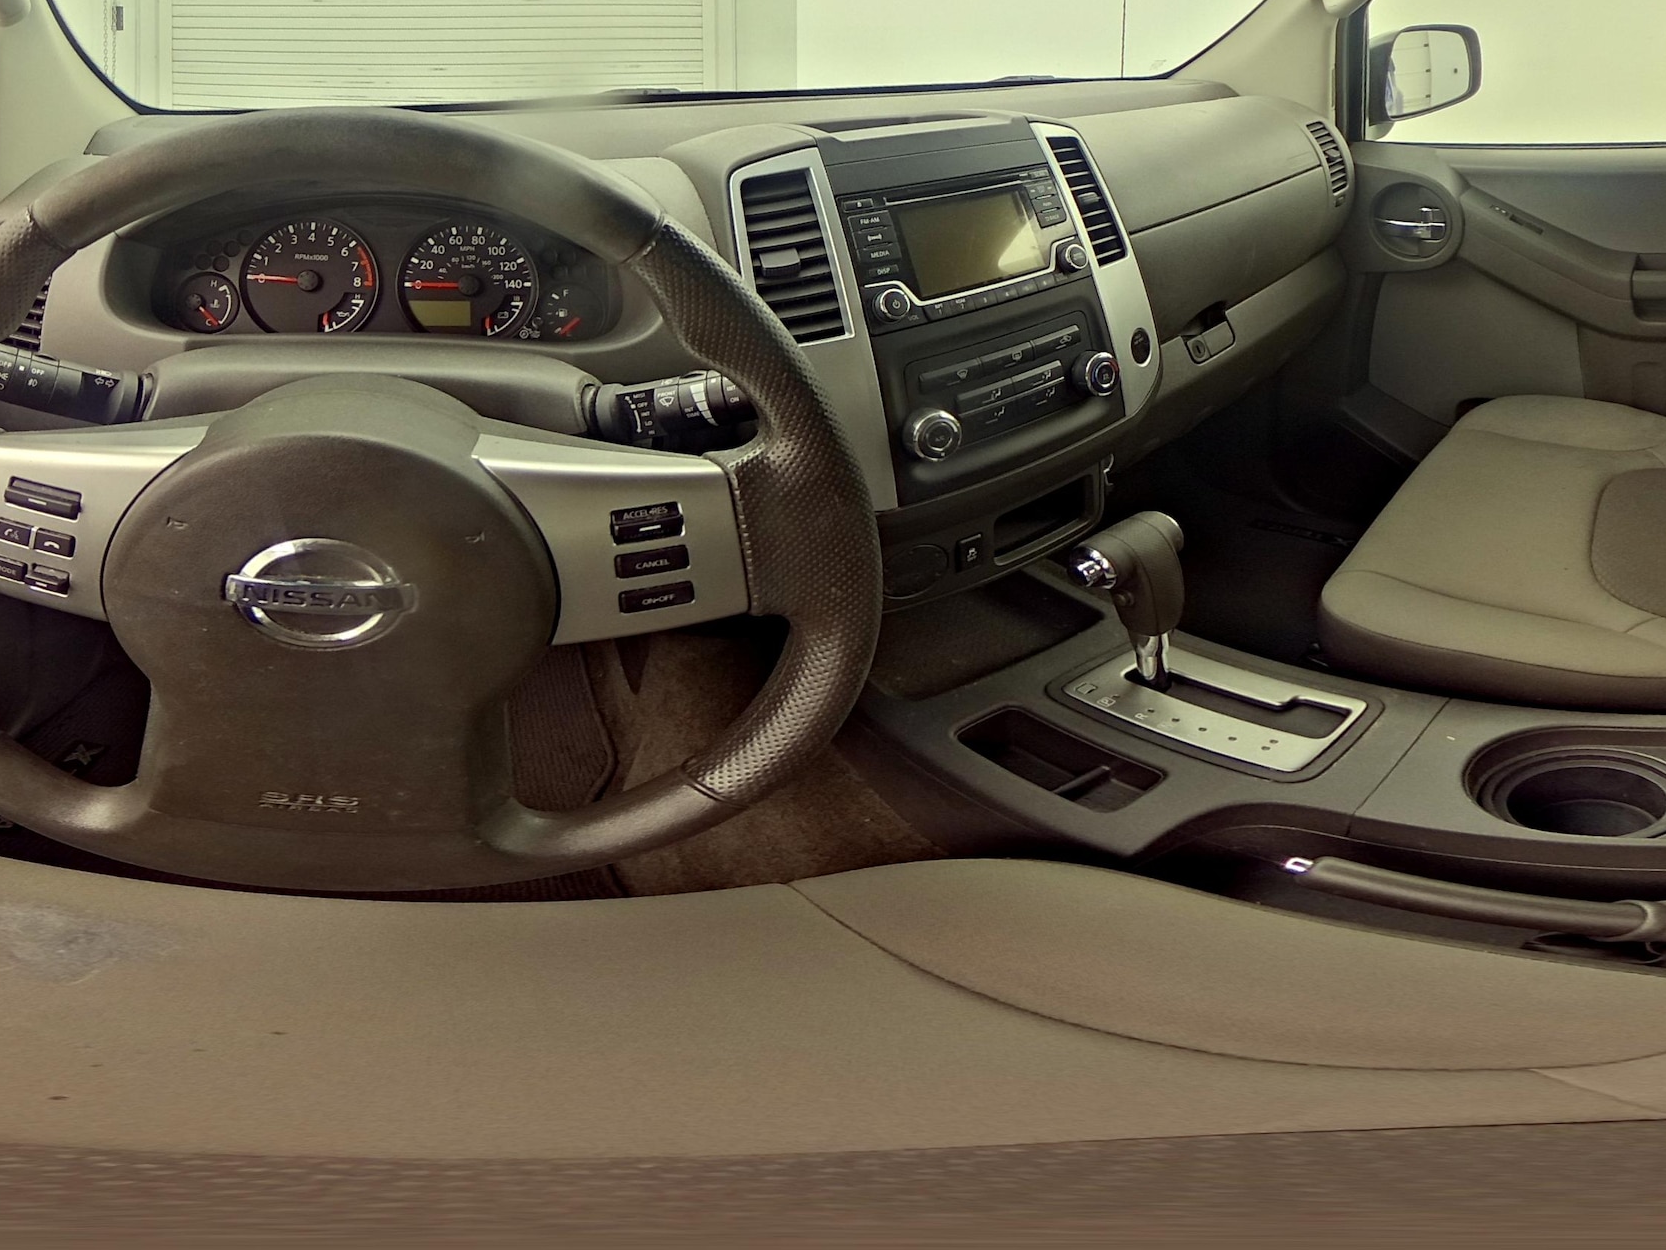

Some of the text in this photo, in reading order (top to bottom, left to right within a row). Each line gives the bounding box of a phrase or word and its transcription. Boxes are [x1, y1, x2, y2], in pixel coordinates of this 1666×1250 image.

[290, 235, 298, 245] 3
[308, 233, 316, 243] 4
[327, 236, 335, 247] 5
[448, 235, 486, 246] 60 80
[275, 242, 283, 253] 2
[340, 247, 349, 257] 6
[431, 245, 446, 255] 40
[487, 246, 506, 256] 100
[870, 250, 891, 258] MEDIA
[263, 257, 269, 266] 1
[419, 260, 435, 270] 20
[499, 261, 518, 271] 120
[351, 262, 359, 272] 7
[877, 267, 891, 275] DISP
[210, 280, 218, 288] H
[353, 277, 362, 287] 8
[504, 279, 523, 290] 140
[562, 289, 570, 298] F
[31, 367, 46, 376] OFF
[635, 558, 671, 570] CANCEL
[242, 584, 399, 611] NISSAN
[1134, 712, 1149, 720] R
